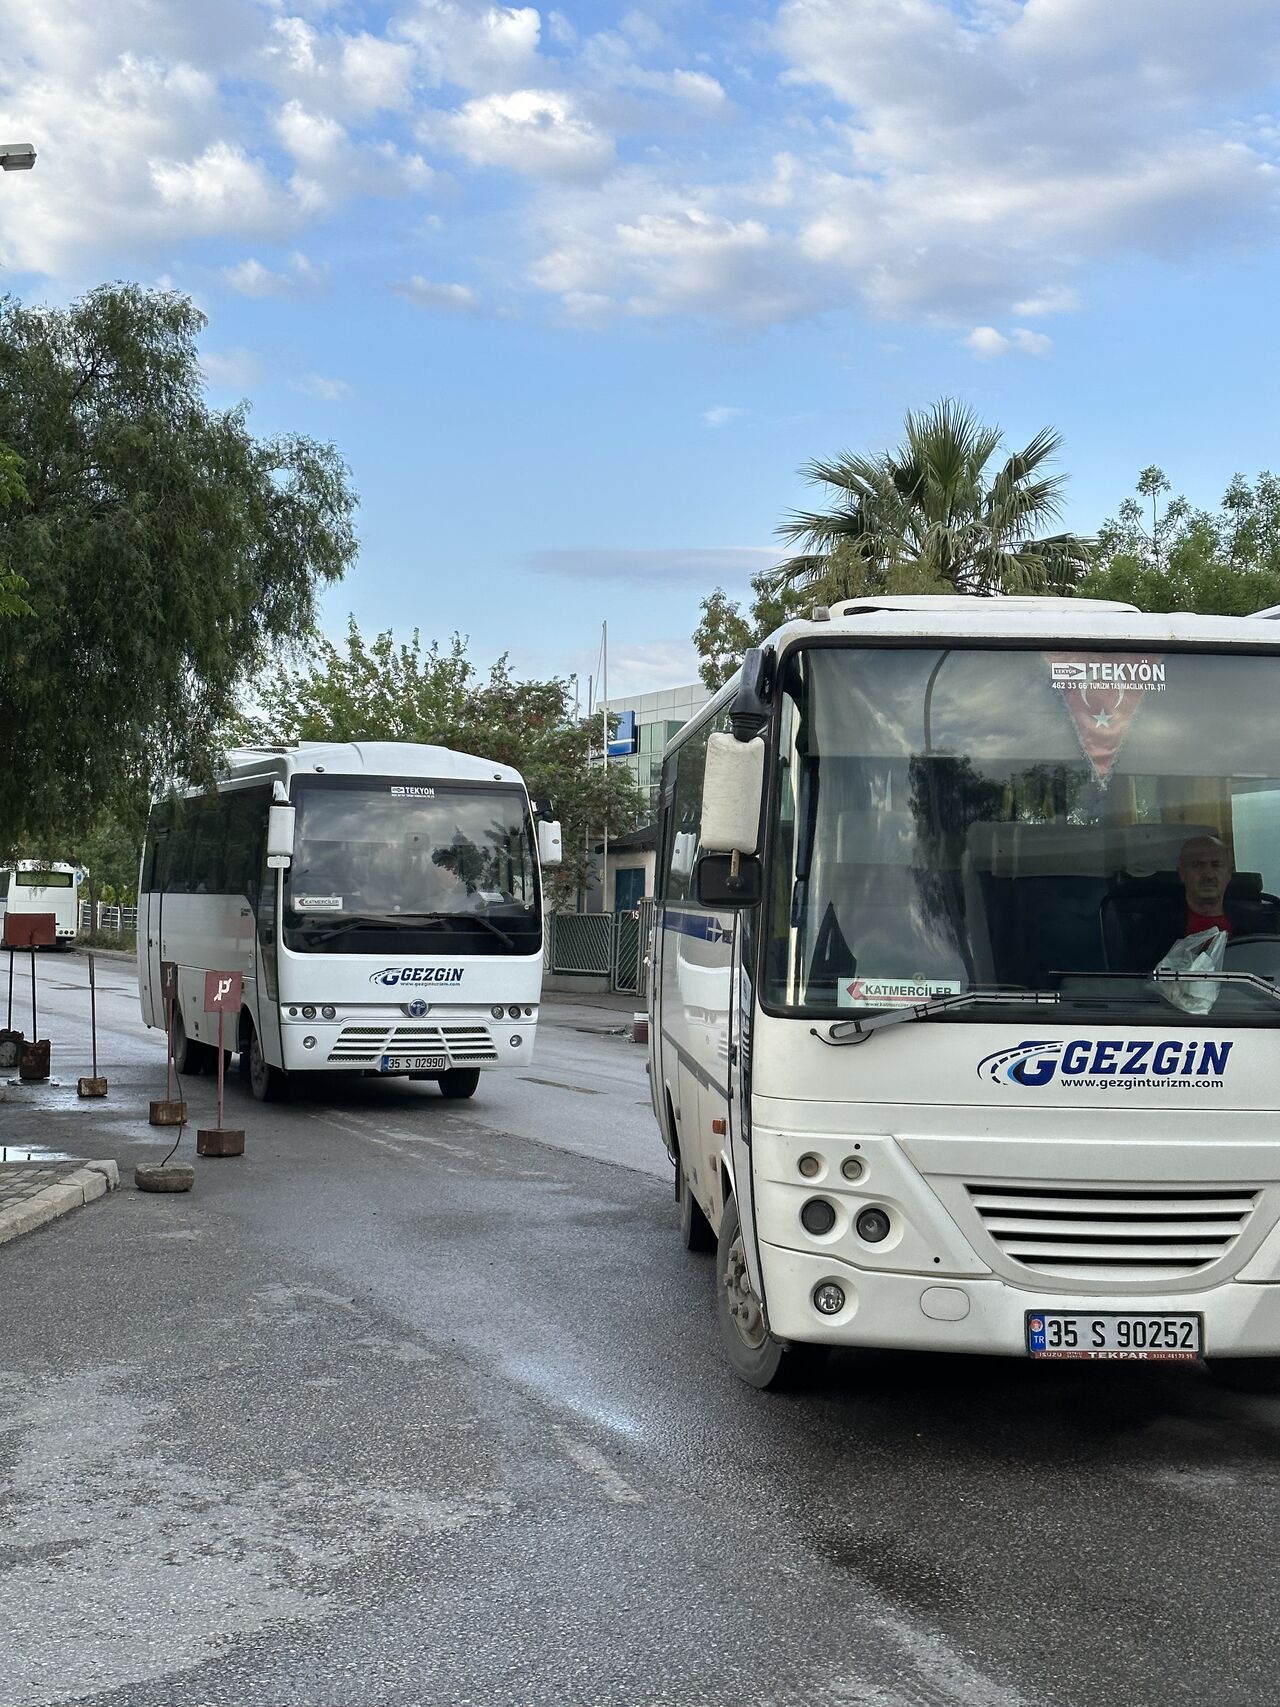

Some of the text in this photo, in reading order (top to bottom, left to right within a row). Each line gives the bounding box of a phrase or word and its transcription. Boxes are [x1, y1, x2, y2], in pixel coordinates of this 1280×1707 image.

[1088, 660, 1166, 682] TEKYÖN
[631, 911, 640, 920] 15
[865, 984, 952, 997] KATMERCİLER
[388, 1057, 444, 1069] 35 S 02990
[1061, 1077, 1224, 1090] www.gezginturizm.com
[1033, 1335, 1045, 1344] TR
[1048, 1320, 1194, 1349] 35 S 90252
[1087, 1351, 1149, 1360] TEKPAR
